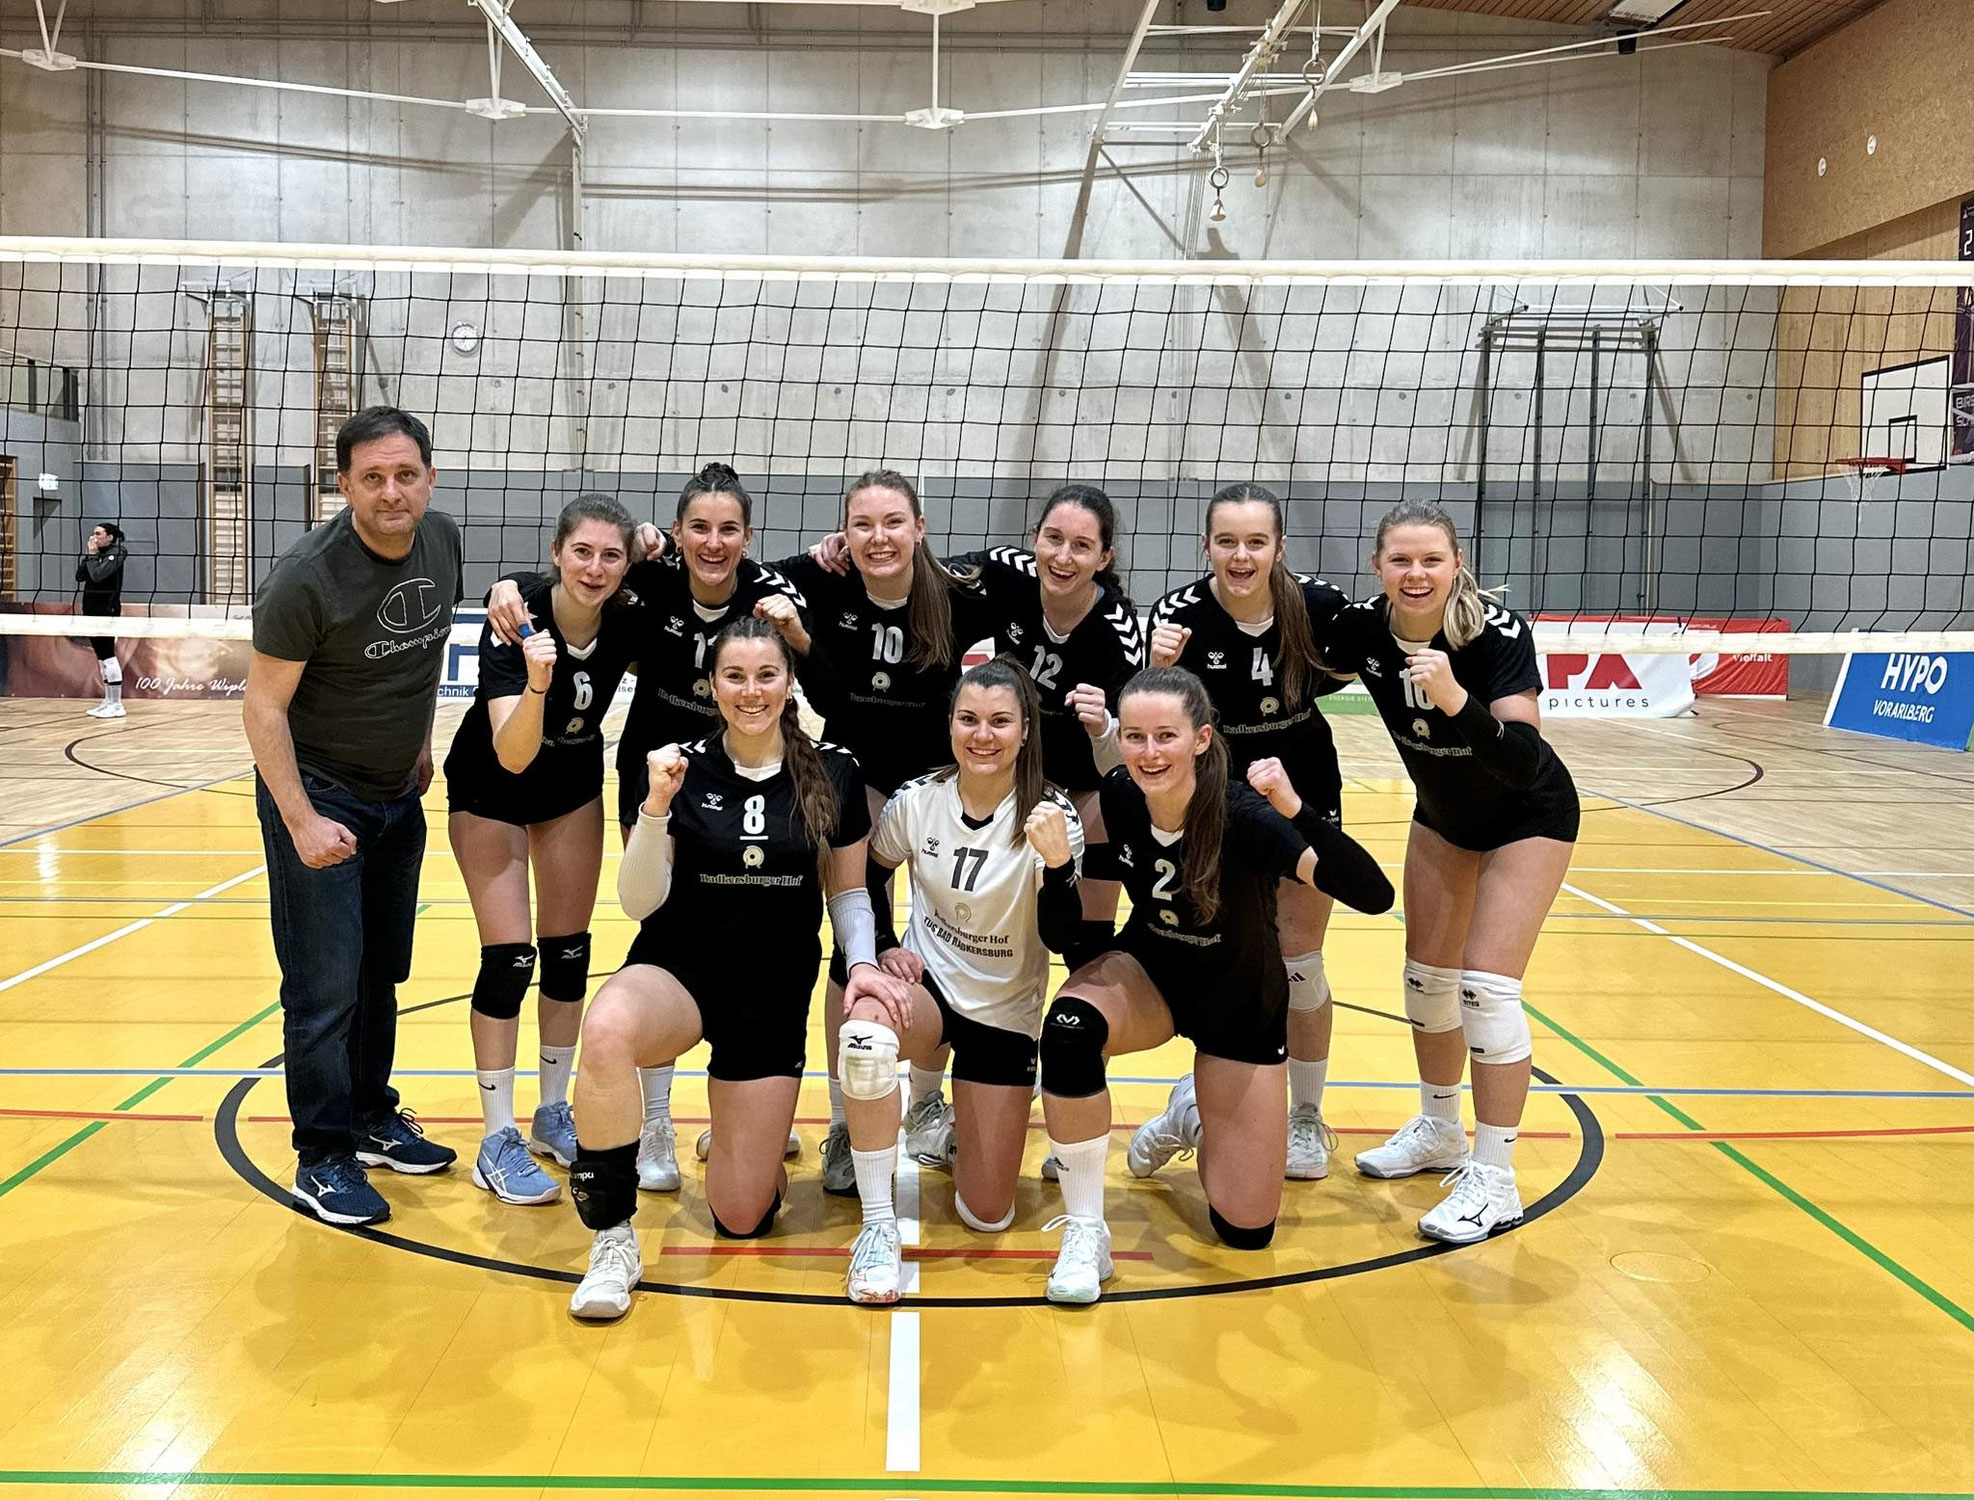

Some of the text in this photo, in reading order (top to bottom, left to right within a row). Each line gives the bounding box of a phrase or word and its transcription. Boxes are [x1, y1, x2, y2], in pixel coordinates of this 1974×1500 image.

[364, 625, 452, 659] Champion
[871, 622, 904, 664] 10
[135, 676, 162, 690] 100
[163, 677, 205, 696] Jahre
[1029, 644, 1064, 691] 12
[1251, 646, 1274, 687] 4
[1880, 653, 1948, 695] HYPO
[573, 671, 594, 711] 6
[1548, 696, 1649, 710] pictures
[1873, 699, 1935, 724] VORARLBERG
[743, 794, 765, 835] 8
[951, 846, 989, 892] 17
[1151, 858, 1176, 901] 2
[936, 926, 952, 944] BAD
[989, 935, 1010, 945] Hof
